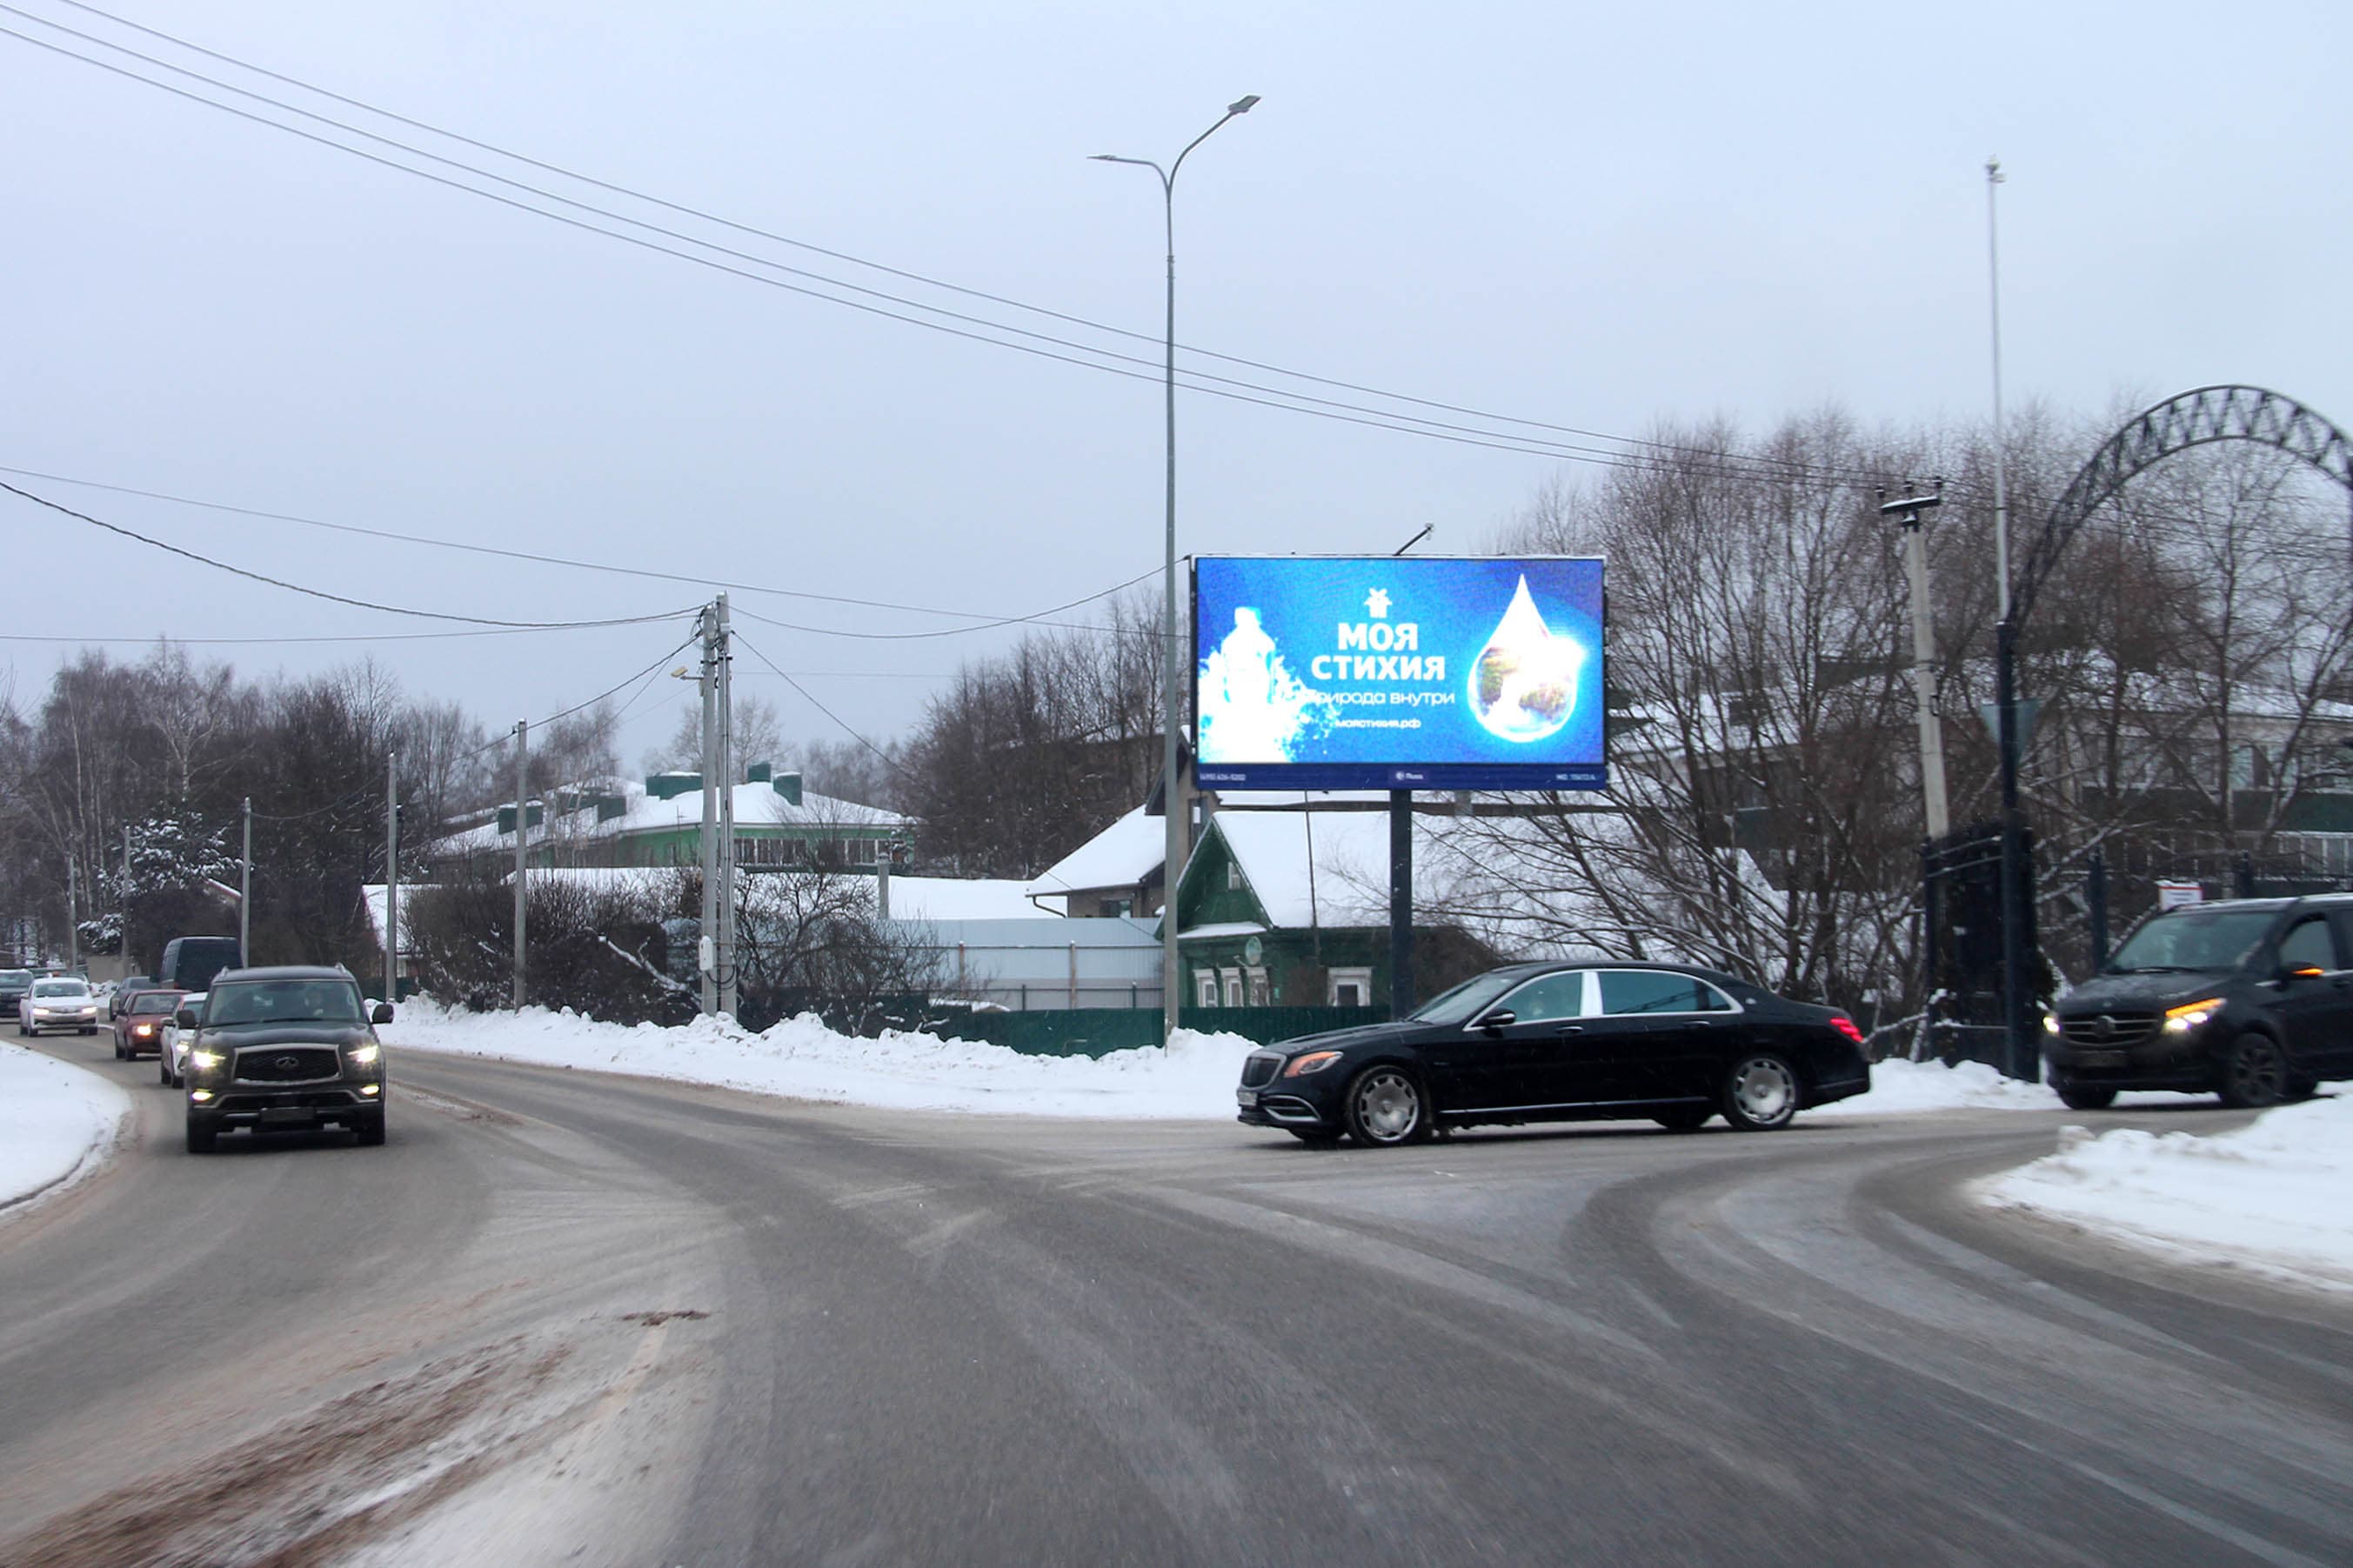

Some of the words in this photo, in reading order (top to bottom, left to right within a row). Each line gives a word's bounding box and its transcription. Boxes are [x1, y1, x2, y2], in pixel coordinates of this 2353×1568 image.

[1338, 623, 1418, 651] МОЯ
[1311, 655, 1446, 680] СТИХИЯ
[1390, 691, 1455, 707] внутри
